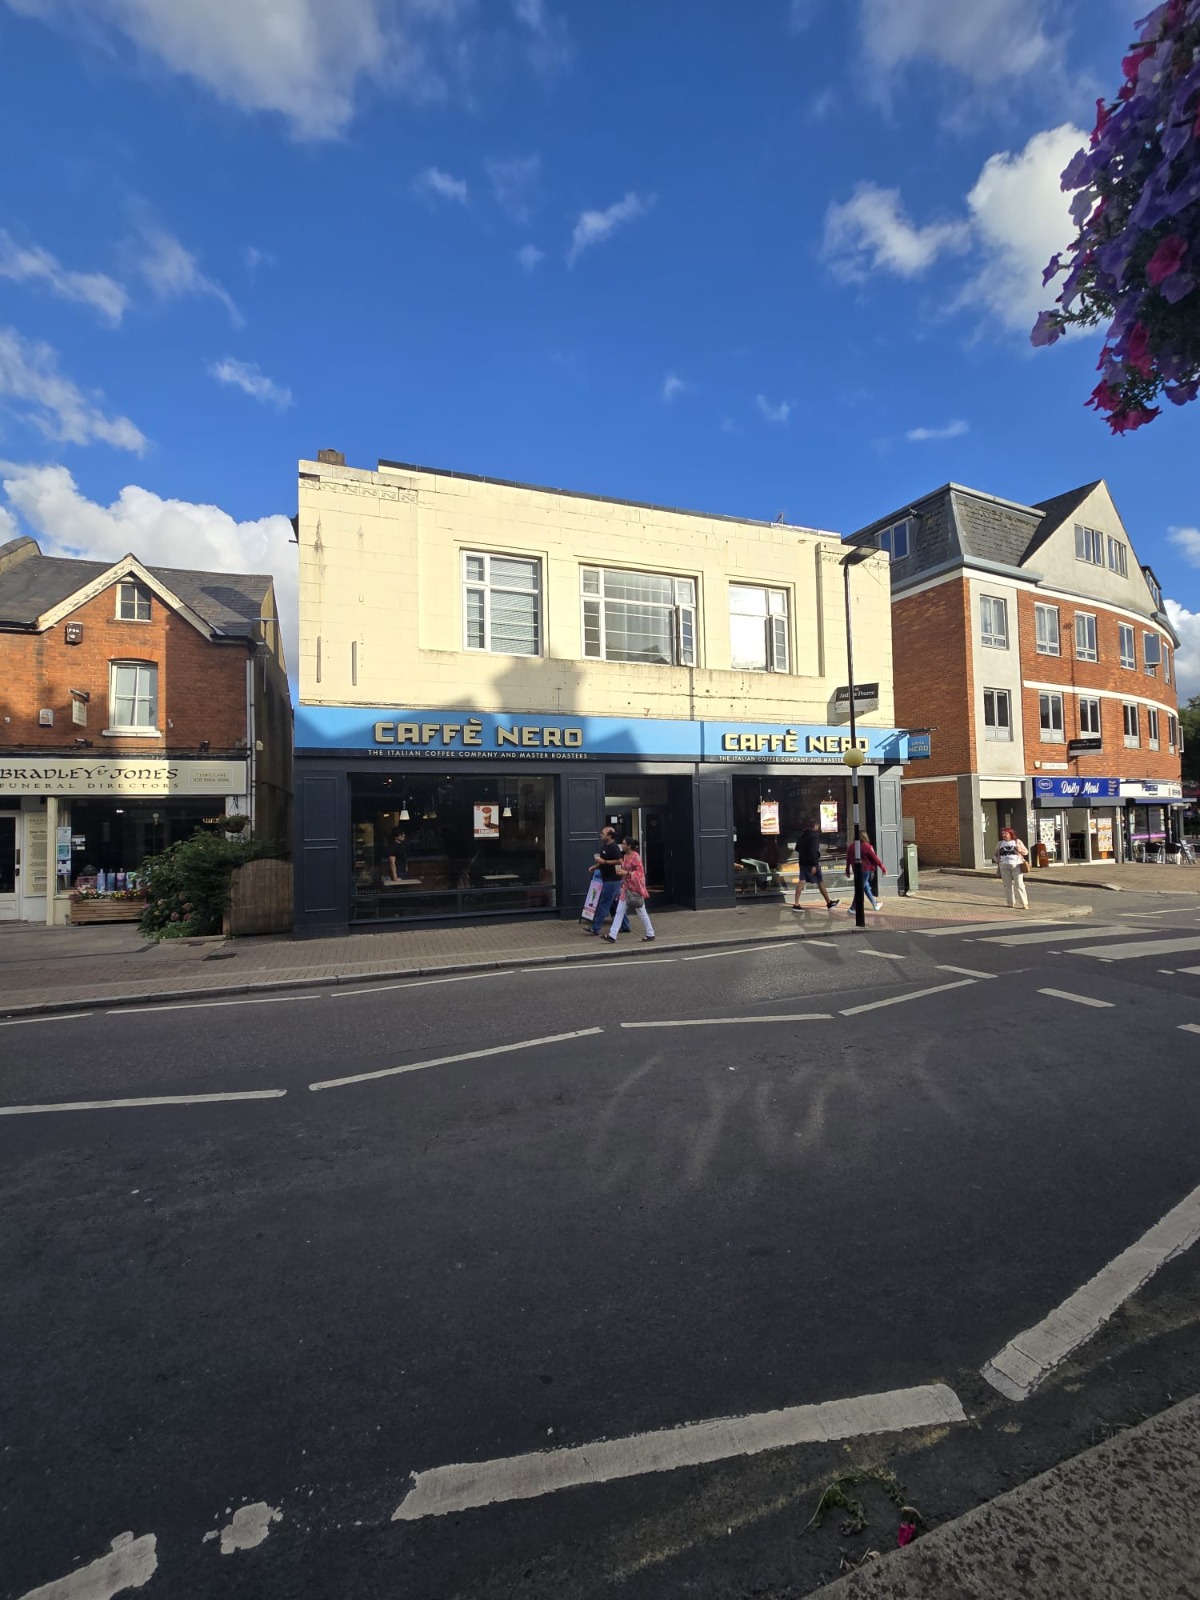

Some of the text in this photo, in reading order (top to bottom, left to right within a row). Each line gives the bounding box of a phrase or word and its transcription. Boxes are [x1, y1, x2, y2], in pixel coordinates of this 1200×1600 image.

[374, 718, 583, 747] CAFFÈ NERO
[722, 729, 869, 754] CAFFÈ NERO
[0, 765, 105, 779] BRADLEY
[109, 768, 179, 780] JONES
[1061, 780, 1080, 796] Daily
[1081, 781, 1100, 795] Meal
